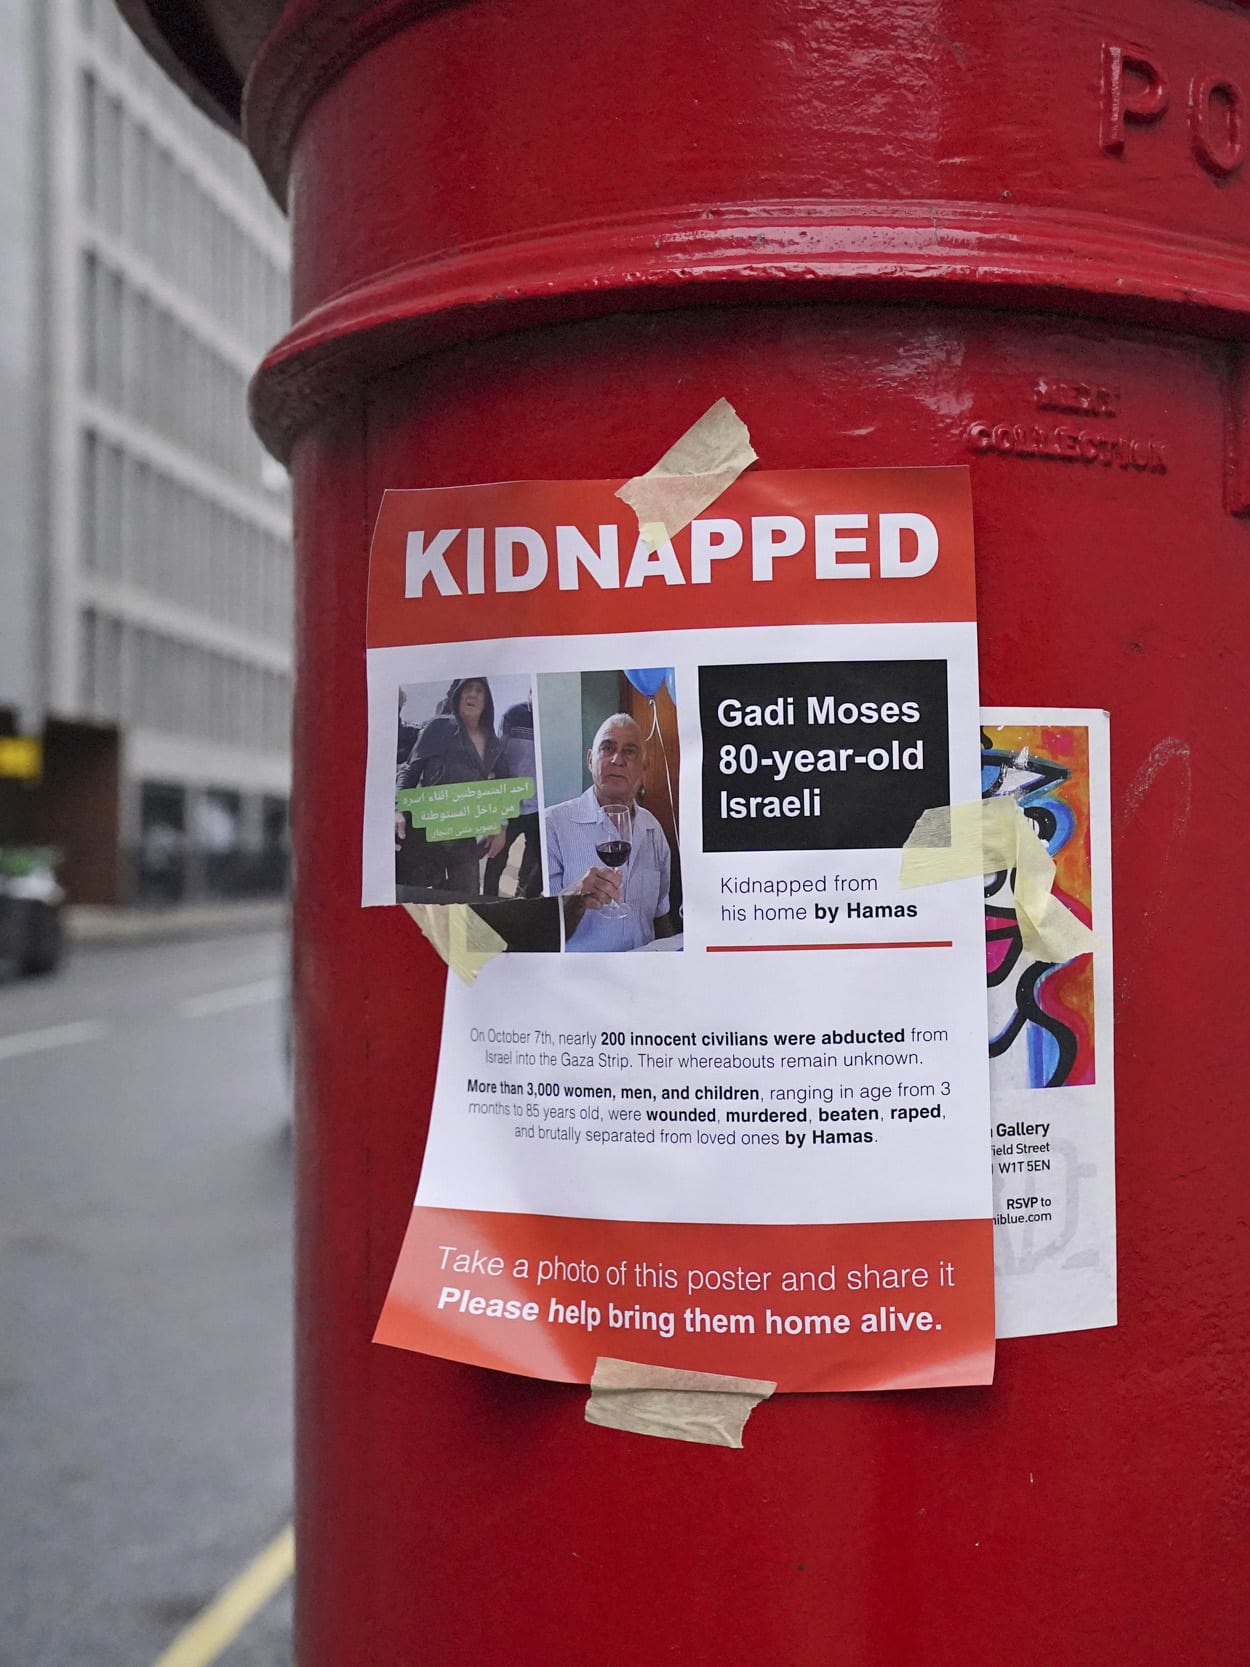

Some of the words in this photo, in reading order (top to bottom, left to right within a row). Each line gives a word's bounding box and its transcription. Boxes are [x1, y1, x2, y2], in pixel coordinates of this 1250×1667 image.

[967, 420, 1168, 474] COLLECTION
[404, 512, 939, 599] KIDNAPPED
[717, 697, 795, 727] Gadi
[807, 696, 921, 725] Moses
[719, 740, 924, 781] 80-year-old
[720, 788, 821, 819] Israeli
[721, 875, 827, 896] Kidnapped
[834, 875, 878, 891] from
[721, 905, 747, 921] his
[754, 904, 807, 920] home
[815, 903, 839, 923] by
[847, 902, 918, 919] Hamas
[470, 1028, 486, 1043] On
[487, 1028, 531, 1044] October
[534, 1030, 555, 1046] 7th,
[559, 1032, 597, 1048] nearly
[601, 1031, 626, 1046] 200
[630, 1031, 697, 1046] innocent
[701, 1032, 768, 1046] civilians
[774, 1033, 816, 1045] were
[821, 1029, 905, 1044] abducted
[910, 1028, 948, 1042] from
[485, 1049, 513, 1064] Israel
[515, 1051, 536, 1065] into
[539, 1052, 557, 1066] the
[560, 1052, 594, 1067] Gaza
[598, 1052, 633, 1070] Strip.
[638, 1053, 673, 1068] Their
[678, 1054, 775, 1069] whereabouts
[781, 1053, 837, 1068] remain
[843, 1052, 923, 1066] unknown.
[467, 1079, 497, 1094] More
[500, 1081, 523, 1096] than
[526, 1082, 560, 1099] 3,000
[563, 1085, 616, 1101] women,
[621, 1087, 656, 1102] men,
[661, 1086, 690, 1100] and
[694, 1085, 764, 1102] children,
[770, 1086, 833, 1104] ranging
[839, 1084, 854, 1099] in
[859, 1085, 892, 1102] age
[898, 1082, 935, 1097] from
[940, 1081, 951, 1096] 3
[468, 1101, 510, 1116] months
[513, 1103, 524, 1116] to
[526, 1103, 540, 1117] 85
[542, 1107, 575, 1120] years
[580, 1106, 604, 1122] old,
[608, 1108, 642, 1121] were
[646, 1107, 720, 1124] wounded,
[726, 1107, 812, 1124] murdered,
[818, 1107, 884, 1121] beaten,
[890, 1104, 946, 1122] raped,
[514, 1125, 535, 1138] and
[538, 1126, 581, 1144] brutally
[585, 1129, 655, 1145] separated
[660, 1129, 692, 1144] from
[697, 1130, 736, 1145] loved
[741, 1132, 780, 1145] ones
[785, 1130, 806, 1148] by
[812, 1130, 878, 1145] Hamas.
[996, 1122, 1050, 1138] Gallery
[991, 1144, 1013, 1156] ield
[1016, 1142, 1050, 1155] Street
[999, 1161, 1025, 1174] W1T
[1027, 1160, 1051, 1172] 5EN
[1006, 1197, 1038, 1210] RSVP
[1040, 1197, 1052, 1207] to
[438, 1245, 505, 1276] Take
[512, 1258, 529, 1278] a
[536, 1255, 599, 1286] photo
[606, 1260, 628, 1286] of
[634, 1262, 678, 1289] this
[688, 1266, 772, 1295] poster
[782, 1265, 836, 1291] and
[847, 1264, 928, 1290] share
[939, 1261, 955, 1287] it
[437, 1286, 539, 1321] Please
[548, 1297, 601, 1331] help
[608, 1302, 675, 1338] bring
[683, 1307, 755, 1333] them
[765, 1309, 851, 1334] home
[861, 1306, 942, 1333] alive.
